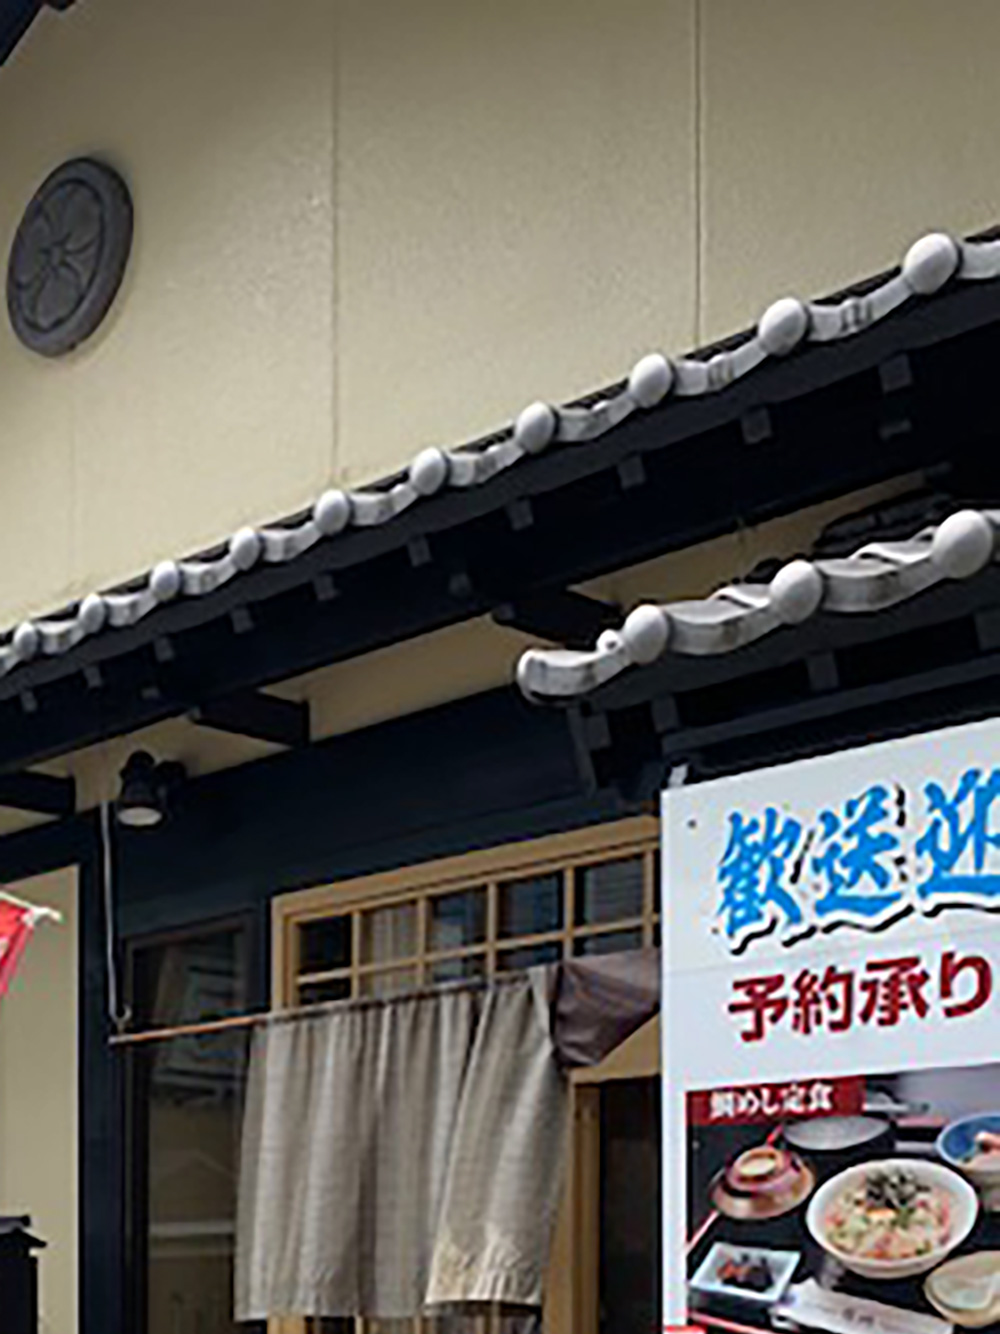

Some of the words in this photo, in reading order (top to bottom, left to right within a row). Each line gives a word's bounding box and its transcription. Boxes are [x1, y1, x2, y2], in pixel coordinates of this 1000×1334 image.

[728, 951, 993, 1042] 予約承り
[709, 1080, 834, 1119] 鯛めし定食
